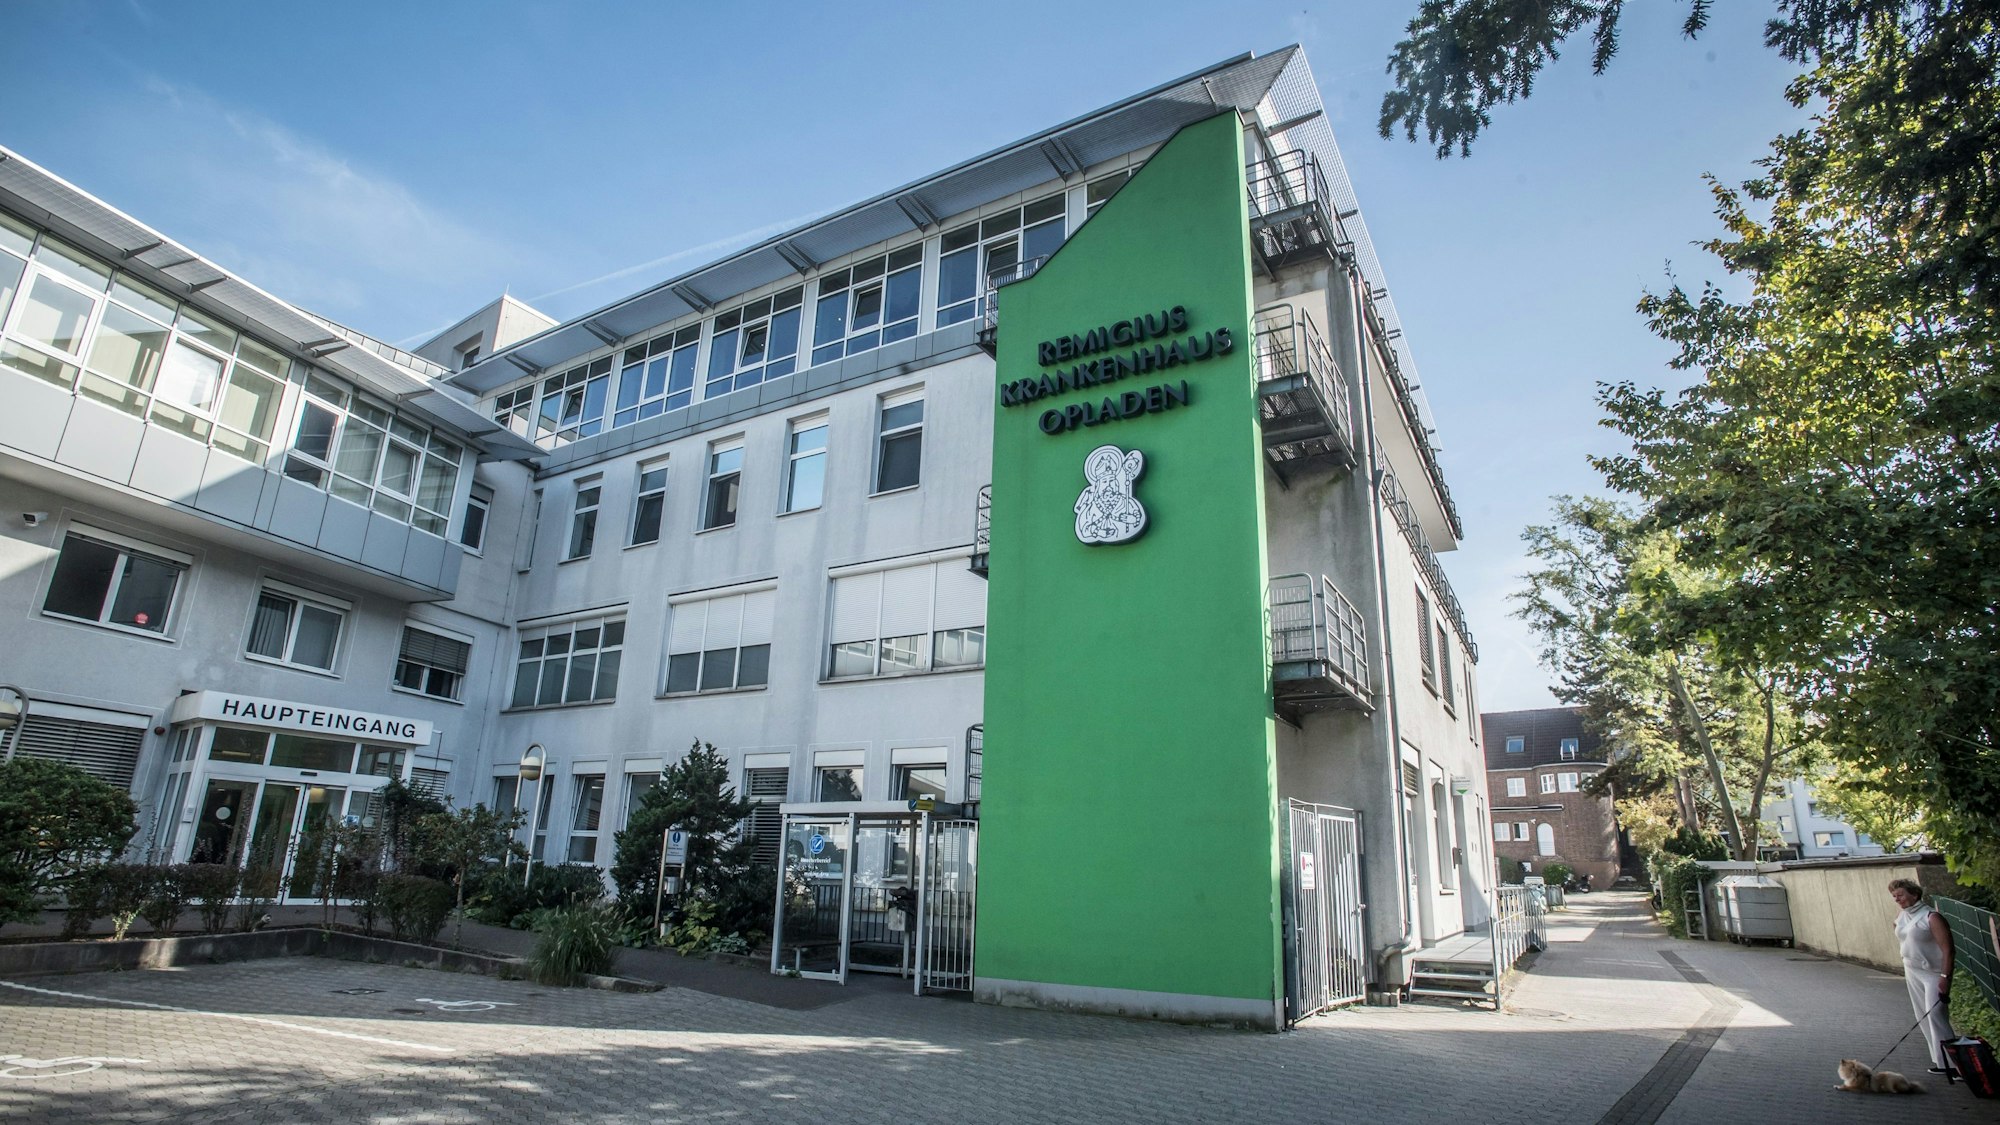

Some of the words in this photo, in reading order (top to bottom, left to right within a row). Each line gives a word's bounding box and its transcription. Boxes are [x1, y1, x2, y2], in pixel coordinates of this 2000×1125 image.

[1038, 305, 1187, 367] REMIGIUS
[1000, 327, 1233, 407] KRANKENHAUS
[1038, 379, 1189, 435] OPLADEN
[222, 699, 417, 738] HAUPTEINGANG
